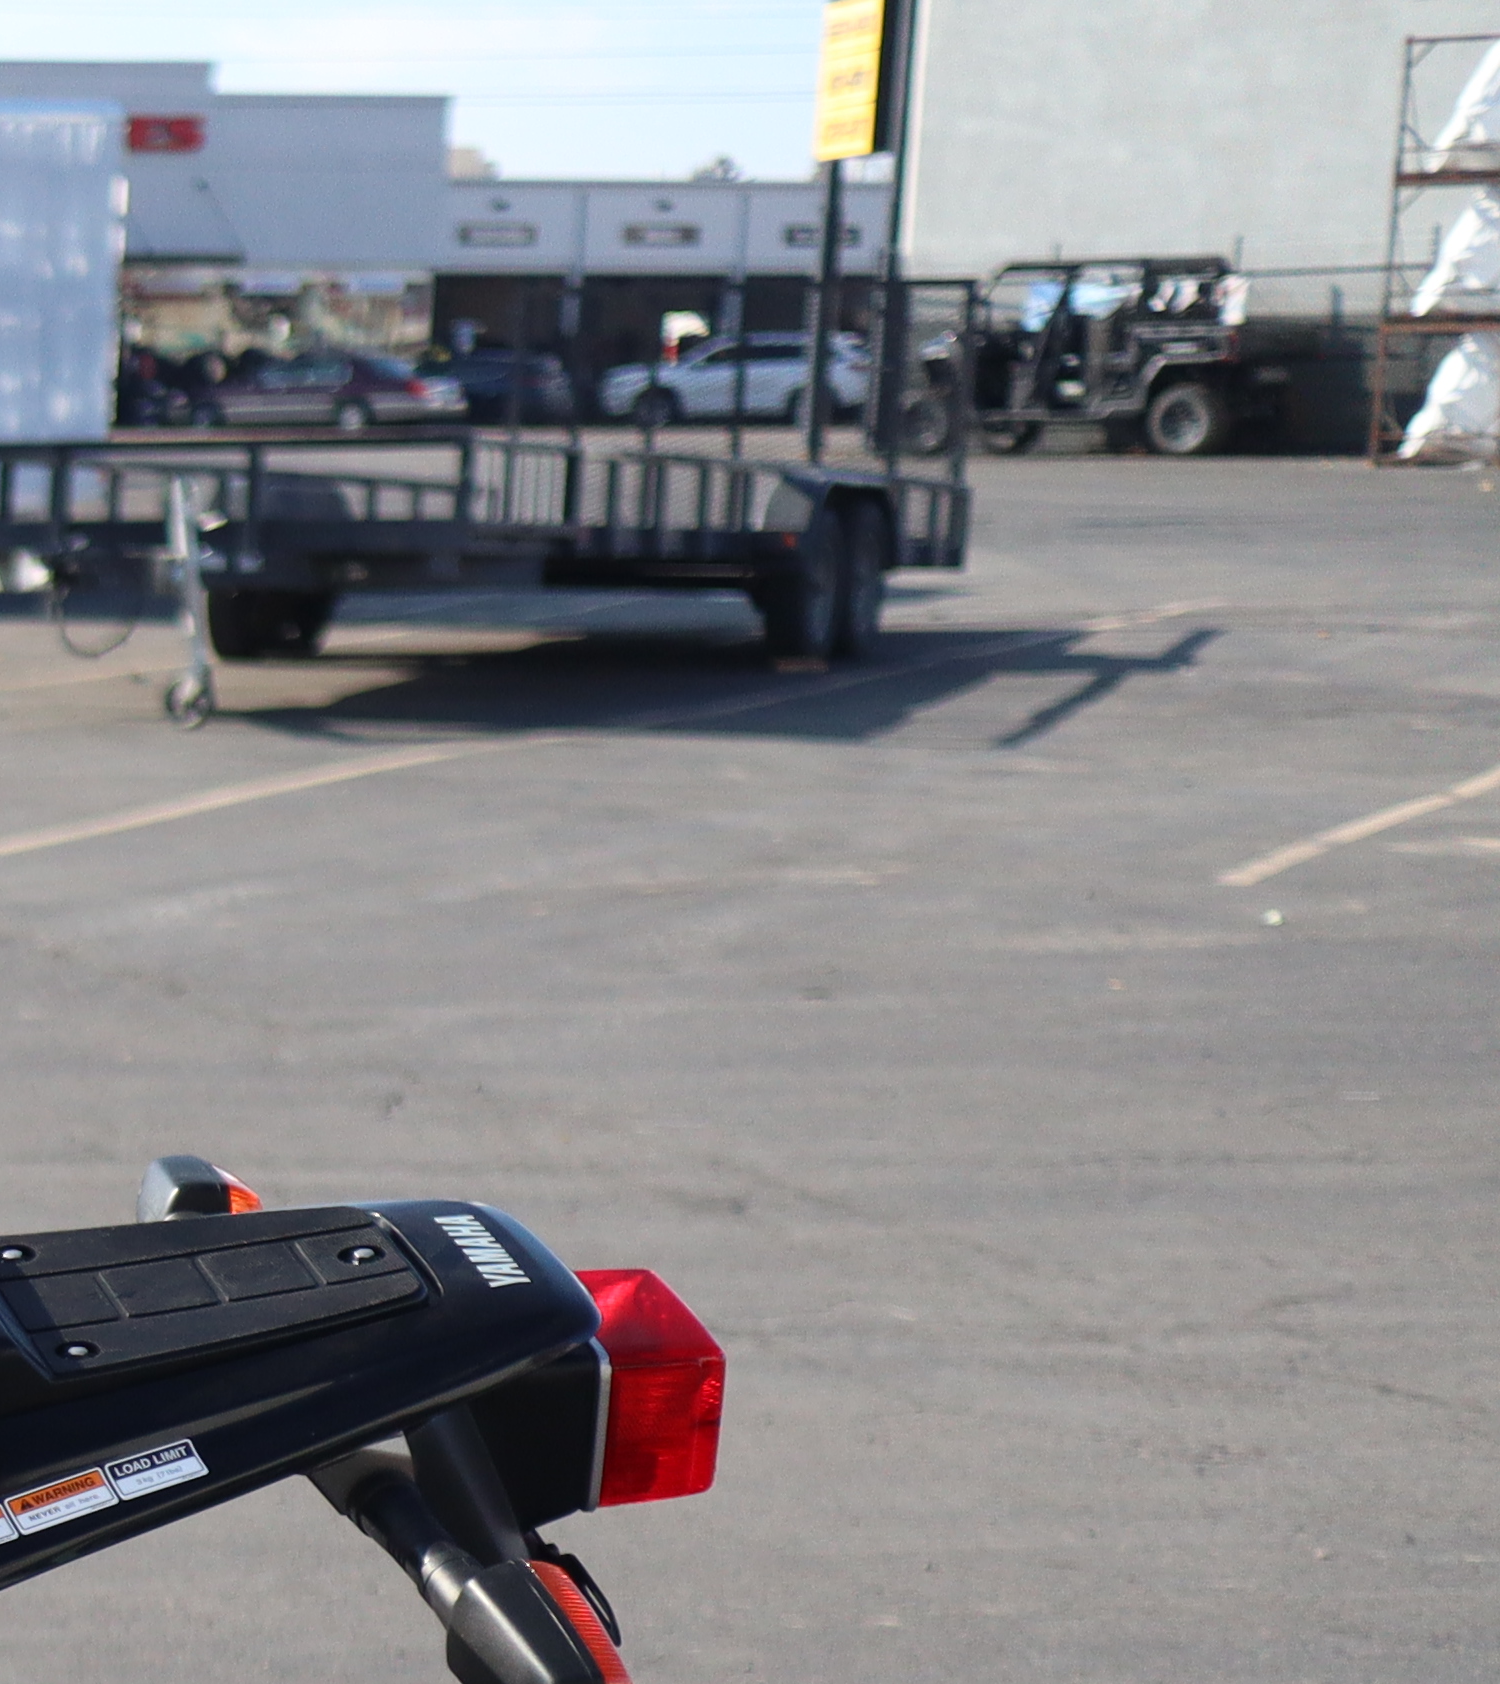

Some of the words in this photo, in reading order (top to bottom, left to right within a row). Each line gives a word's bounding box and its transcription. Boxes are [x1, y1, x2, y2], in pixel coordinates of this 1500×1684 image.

[434, 1215, 532, 1288] YAMAHA
[113, 1457, 152, 1477] LOAD
[152, 1445, 187, 1465] LIMIT
[32, 1477, 96, 1503] WARNING
